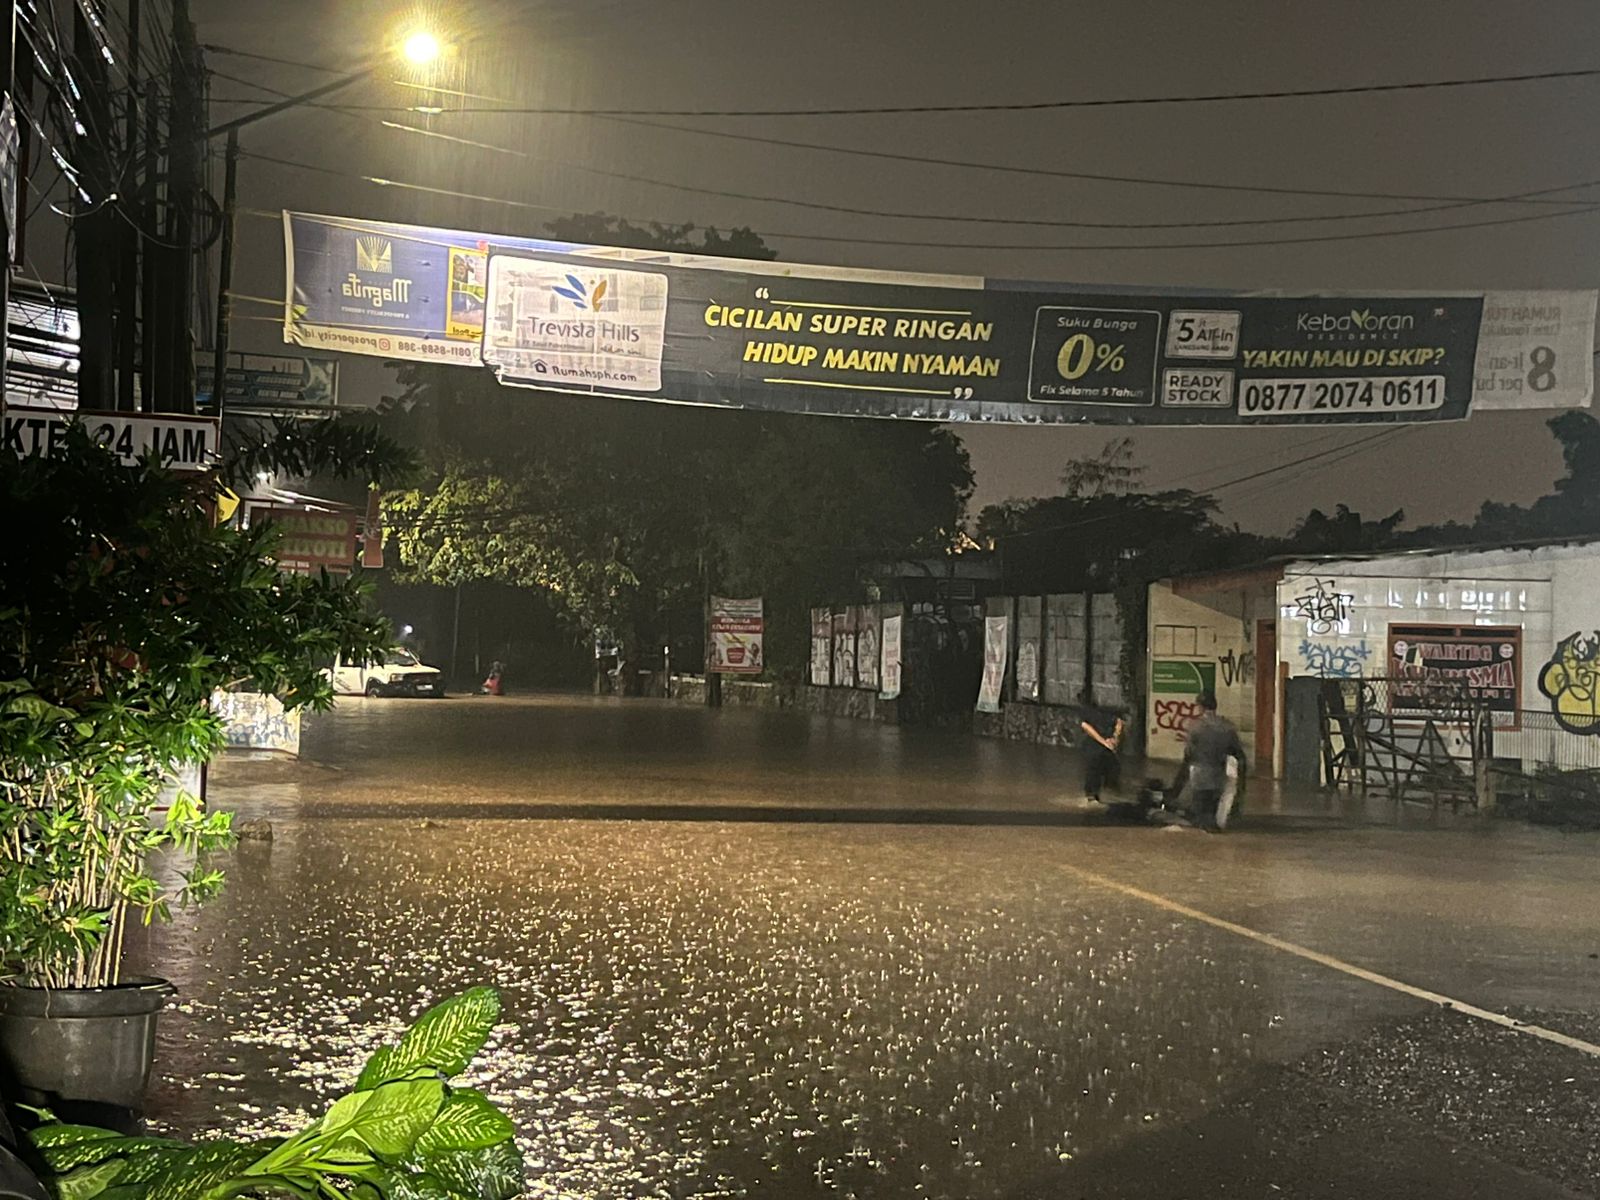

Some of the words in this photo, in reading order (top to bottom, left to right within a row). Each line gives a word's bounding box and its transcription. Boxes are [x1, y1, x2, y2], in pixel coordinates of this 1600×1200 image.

[527, 316, 596, 339] Trevista
[601, 322, 640, 343] Hills
[704, 305, 803, 332] CICILAN
[809, 314, 886, 338] SUPER
[893, 318, 994, 341] RINGAN
[1057, 316, 1090, 329] Suku
[1093, 318, 1138, 331] Bunga
[1177, 318, 1194, 342] 5
[743, 341, 818, 366] HIDUP
[822, 348, 899, 373] MAKIN
[902, 354, 1000, 377] NYAMAN
[1057, 333, 1125, 380] 0%
[1242, 350, 1309, 368] YAKIN
[1310, 350, 1359, 368] MAU
[1363, 350, 1383, 367] DI
[1388, 348, 1445, 367] SKIP?
[552, 365, 638, 383] Rumahsph.com
[1169, 375, 1225, 388] READY
[1039, 385, 1057, 395] Fix
[1058, 385, 1100, 397] Selama
[1110, 387, 1144, 398] Tahun
[1167, 389, 1221, 402] STOCK
[1245, 384, 1306, 411] 0877
[1314, 382, 1374, 408] 2074
[1382, 379, 1439, 405] 0611
